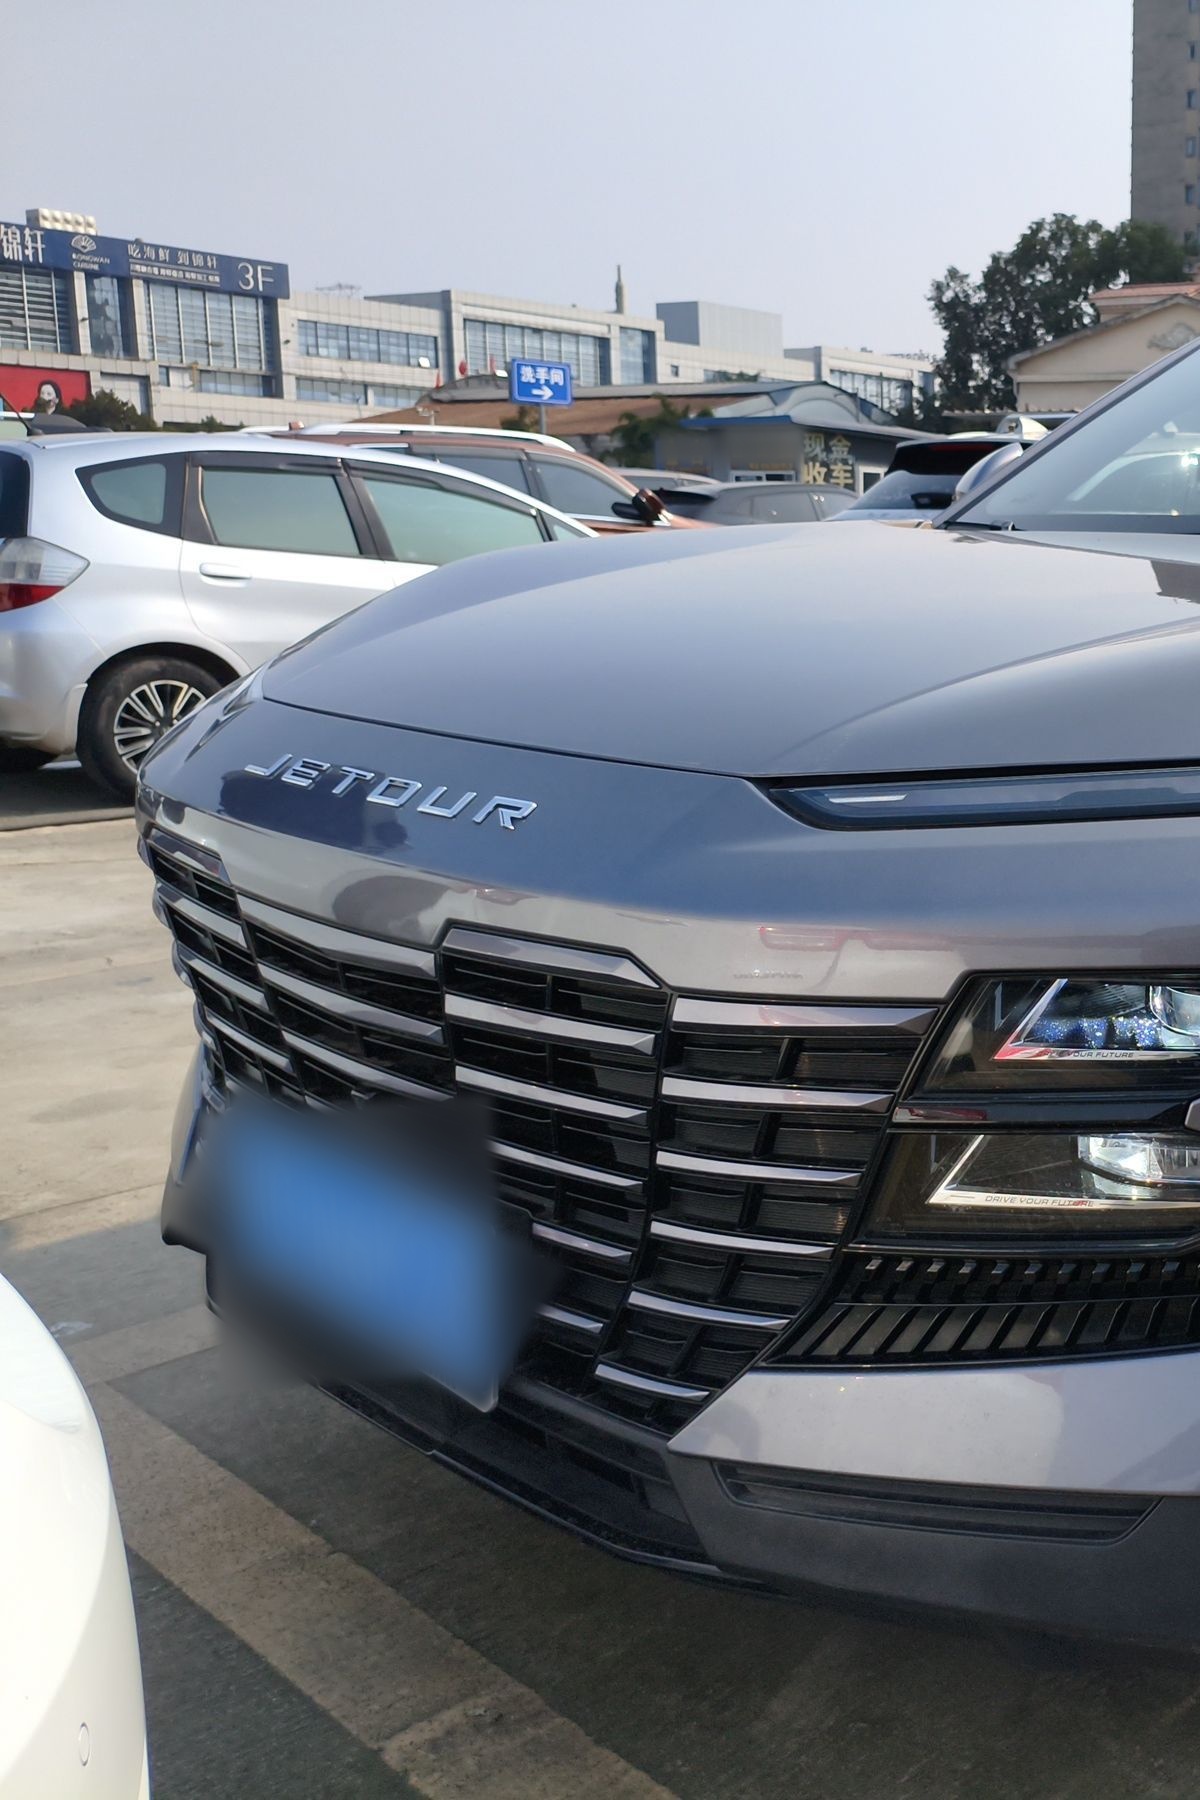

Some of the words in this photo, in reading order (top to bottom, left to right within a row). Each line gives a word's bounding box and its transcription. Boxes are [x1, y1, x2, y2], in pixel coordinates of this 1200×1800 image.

[237, 262, 274, 292] 3F
[520, 365, 565, 387] 洗手间
[803, 432, 855, 464] 现金
[803, 462, 854, 487] 收车
[244, 753, 538, 831] JETOUR
[1095, 1051, 1134, 1059] FUTURE
[985, 1195, 1017, 1203] DRIVE
[1019, 1196, 1049, 1205] YOUR
[1051, 1198, 1095, 1207] FUTURE
